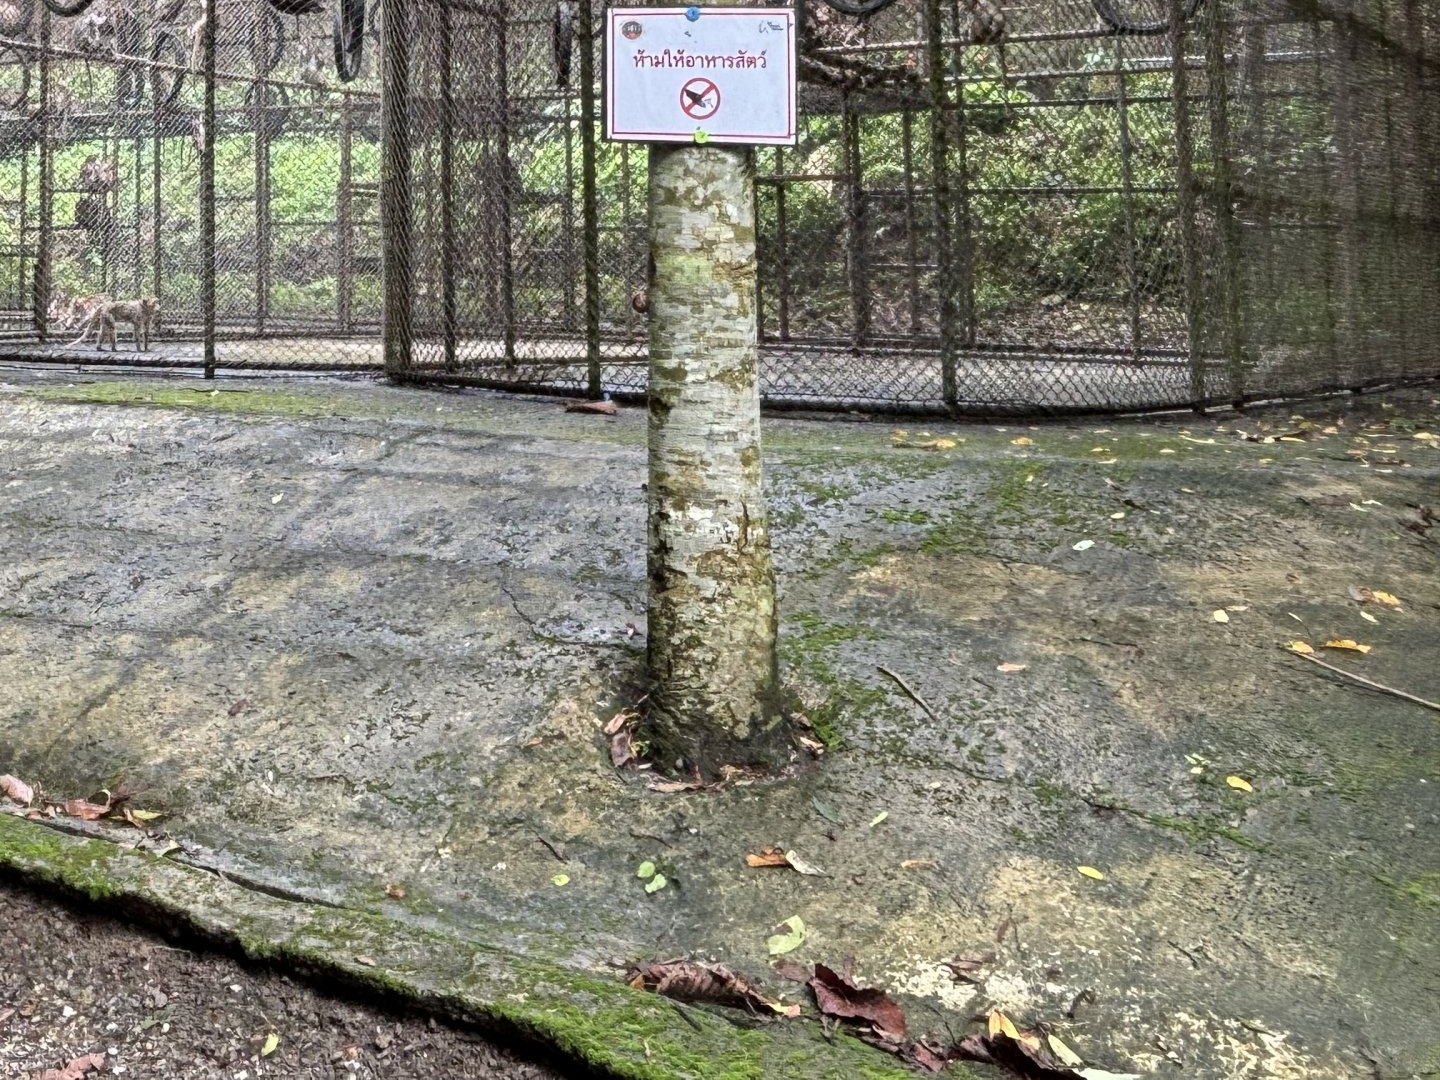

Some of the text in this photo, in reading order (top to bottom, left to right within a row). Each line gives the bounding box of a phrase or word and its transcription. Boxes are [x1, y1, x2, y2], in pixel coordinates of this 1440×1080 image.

[633, 49, 767, 69] ห้ามให้อาหารสัตว์
